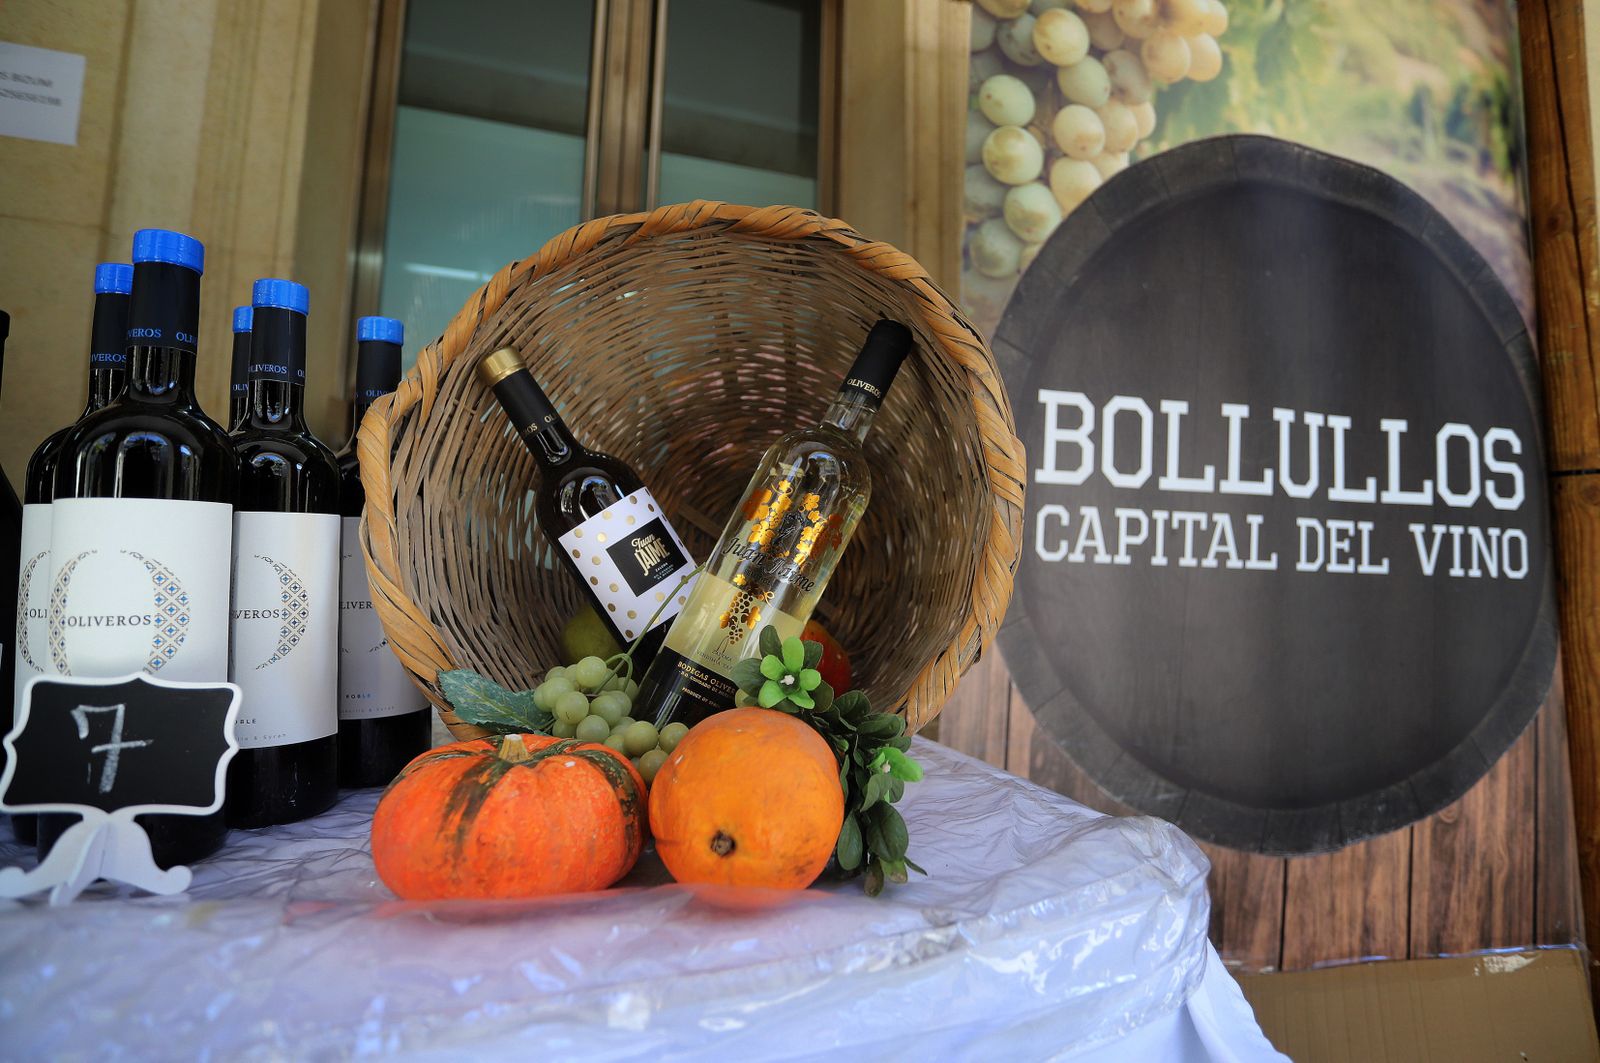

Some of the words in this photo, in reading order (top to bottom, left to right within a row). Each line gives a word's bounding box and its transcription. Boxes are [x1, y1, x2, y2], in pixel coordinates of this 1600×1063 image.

[1035, 389, 1525, 511] BOLLULLOS
[631, 533, 656, 552] Juan
[634, 537, 670, 576] JAIME
[722, 537, 763, 566] Juan
[1035, 504, 1278, 570] CAPITAL
[1296, 516, 1389, 574] DEL
[1409, 523, 1528, 579] VINO
[67, 614, 152, 628] OLIVEROS
[677, 660, 709, 681] BODEGAS
[70, 703, 155, 793] 7
